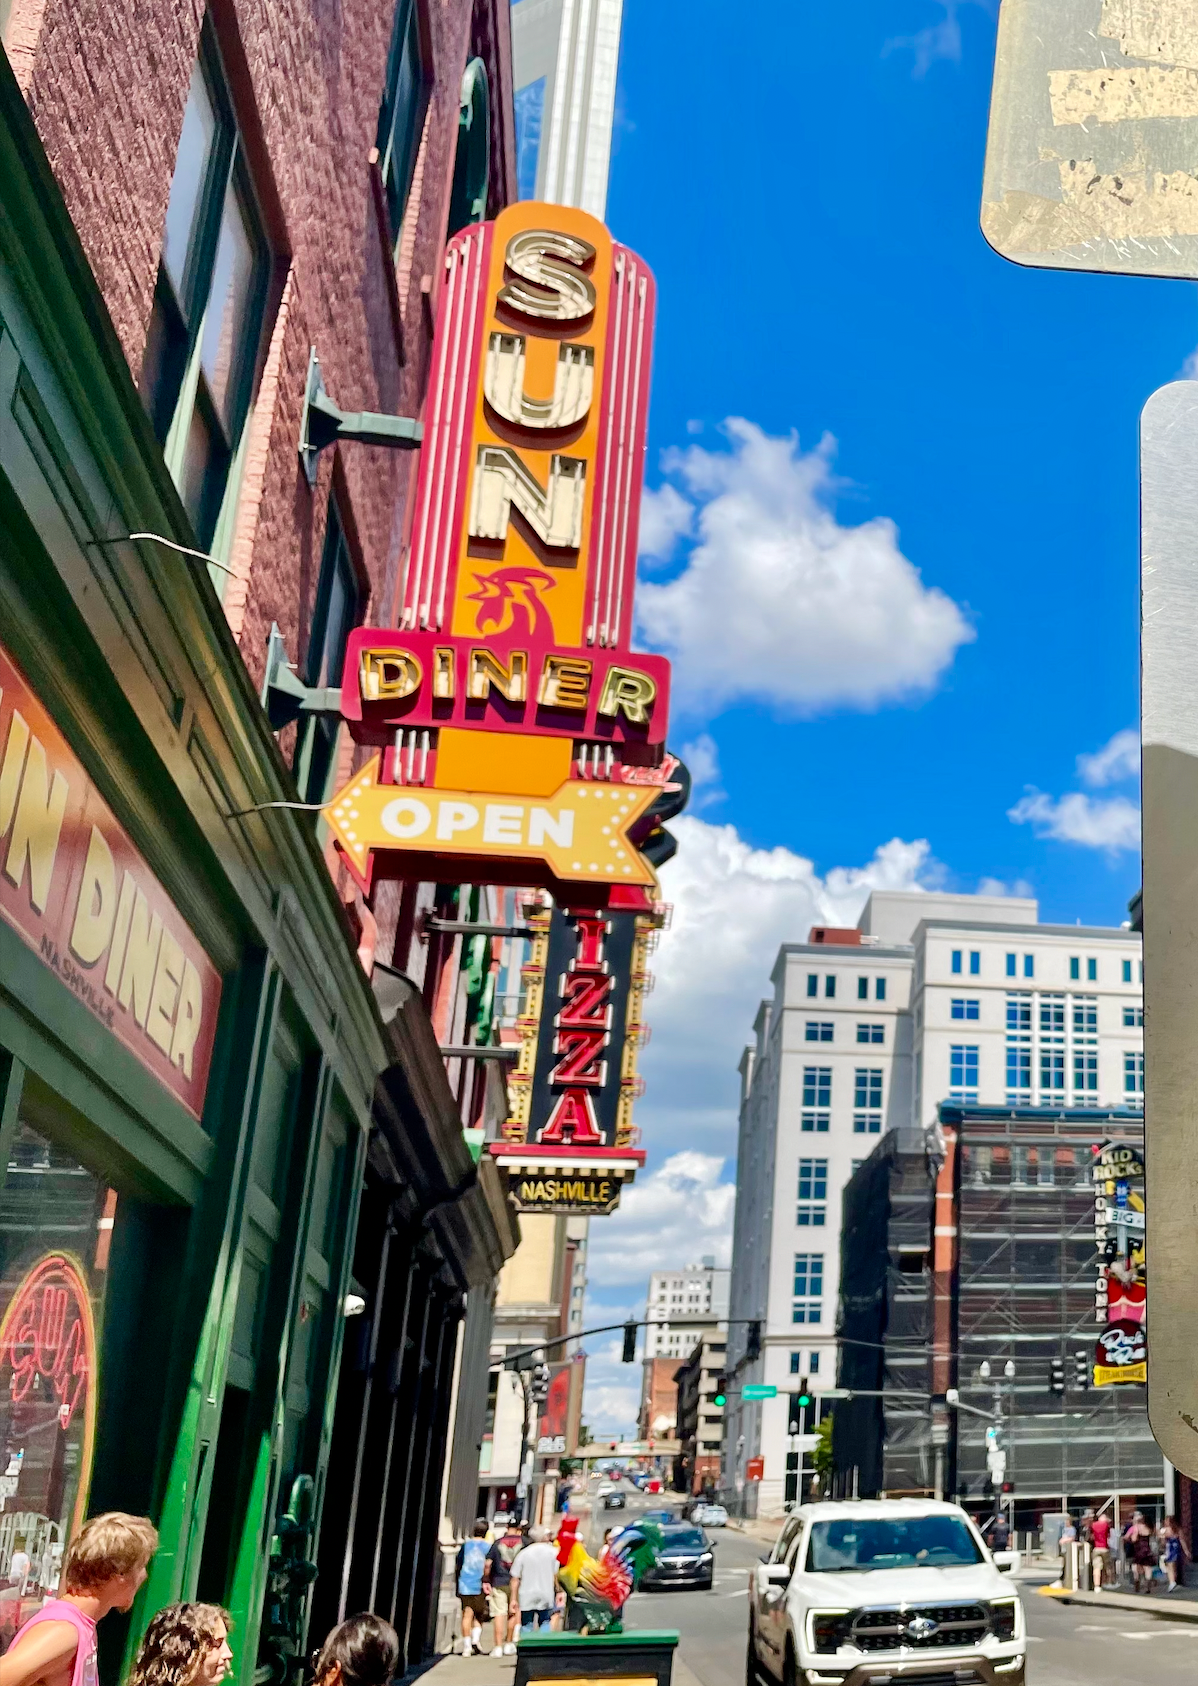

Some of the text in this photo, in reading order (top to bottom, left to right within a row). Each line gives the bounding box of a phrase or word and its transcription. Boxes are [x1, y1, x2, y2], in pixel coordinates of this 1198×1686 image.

[468, 228, 596, 549] SUN
[361, 647, 657, 723] DINER
[381, 797, 575, 848] OPEN
[41, 933, 114, 1028] NASHVILLE
[69, 824, 201, 1083] DINER
[535, 909, 615, 1146] IZZA
[521, 1180, 610, 1202] NASHVILLE
[1101, 1149, 1133, 1165] KID
